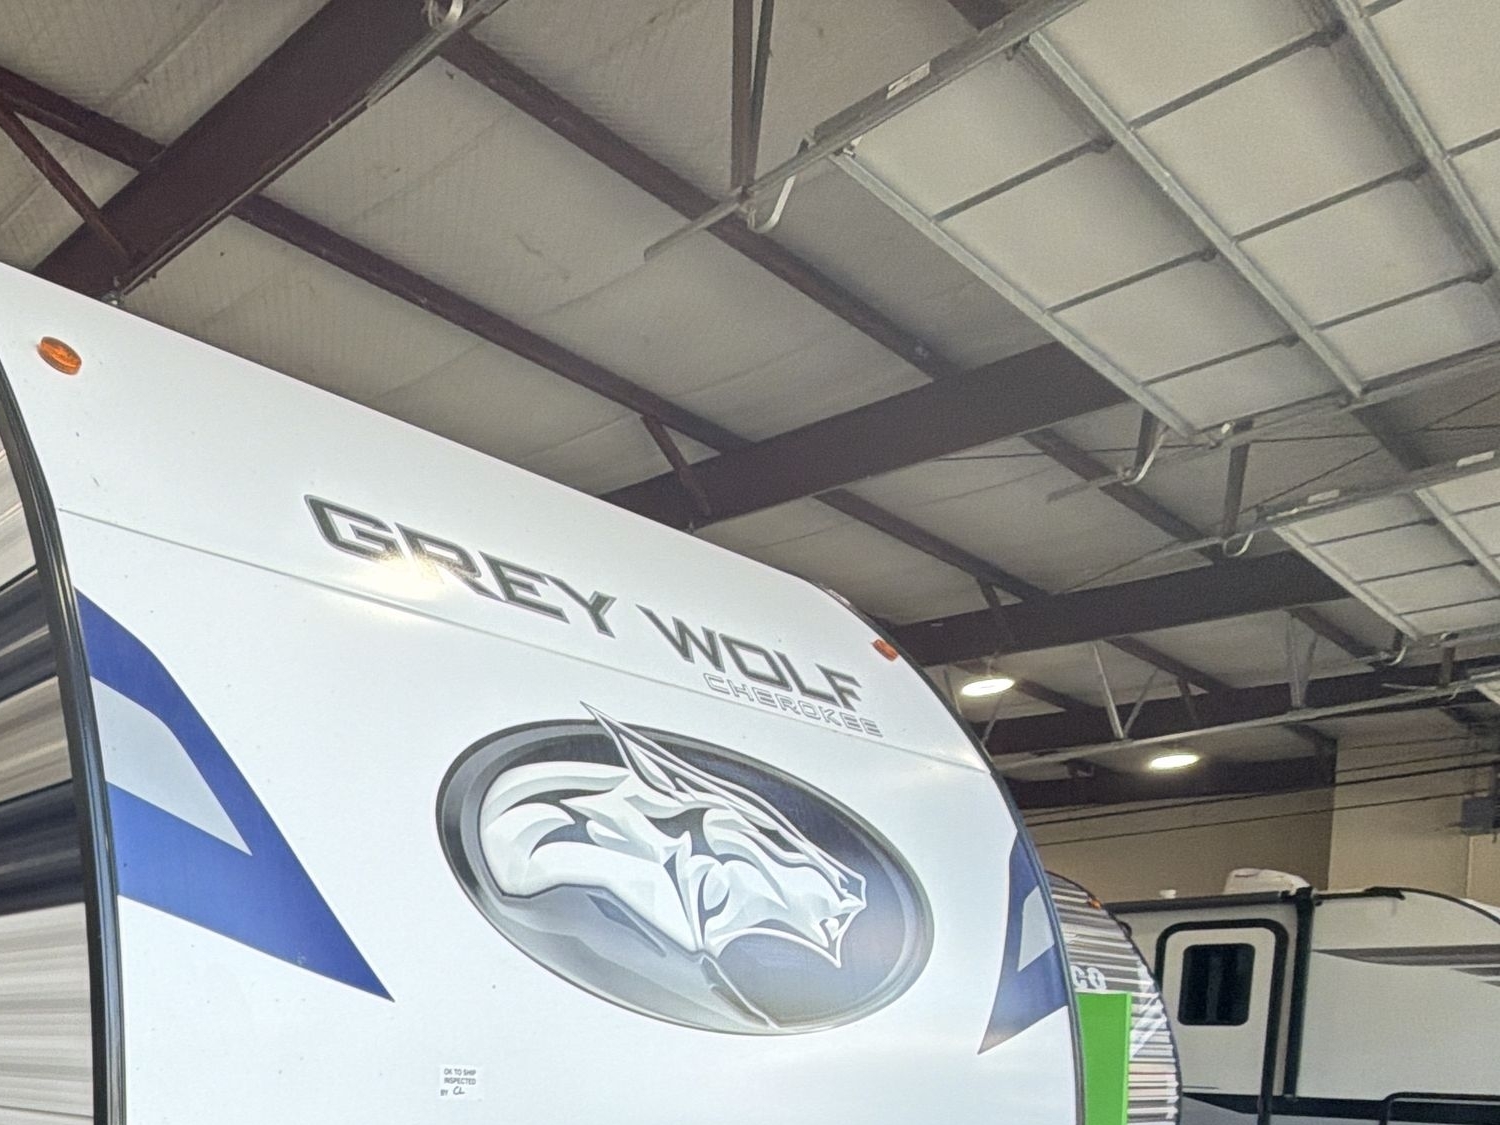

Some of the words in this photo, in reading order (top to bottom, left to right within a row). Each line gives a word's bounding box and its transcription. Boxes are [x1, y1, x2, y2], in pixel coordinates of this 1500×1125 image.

[303, 494, 616, 638] GREY
[636, 605, 862, 711] WOLF
[703, 673, 882, 738] CHEROKEE
[444, 1077, 476, 1085] INSPECTED
[454, 1068, 462, 1076] TO
